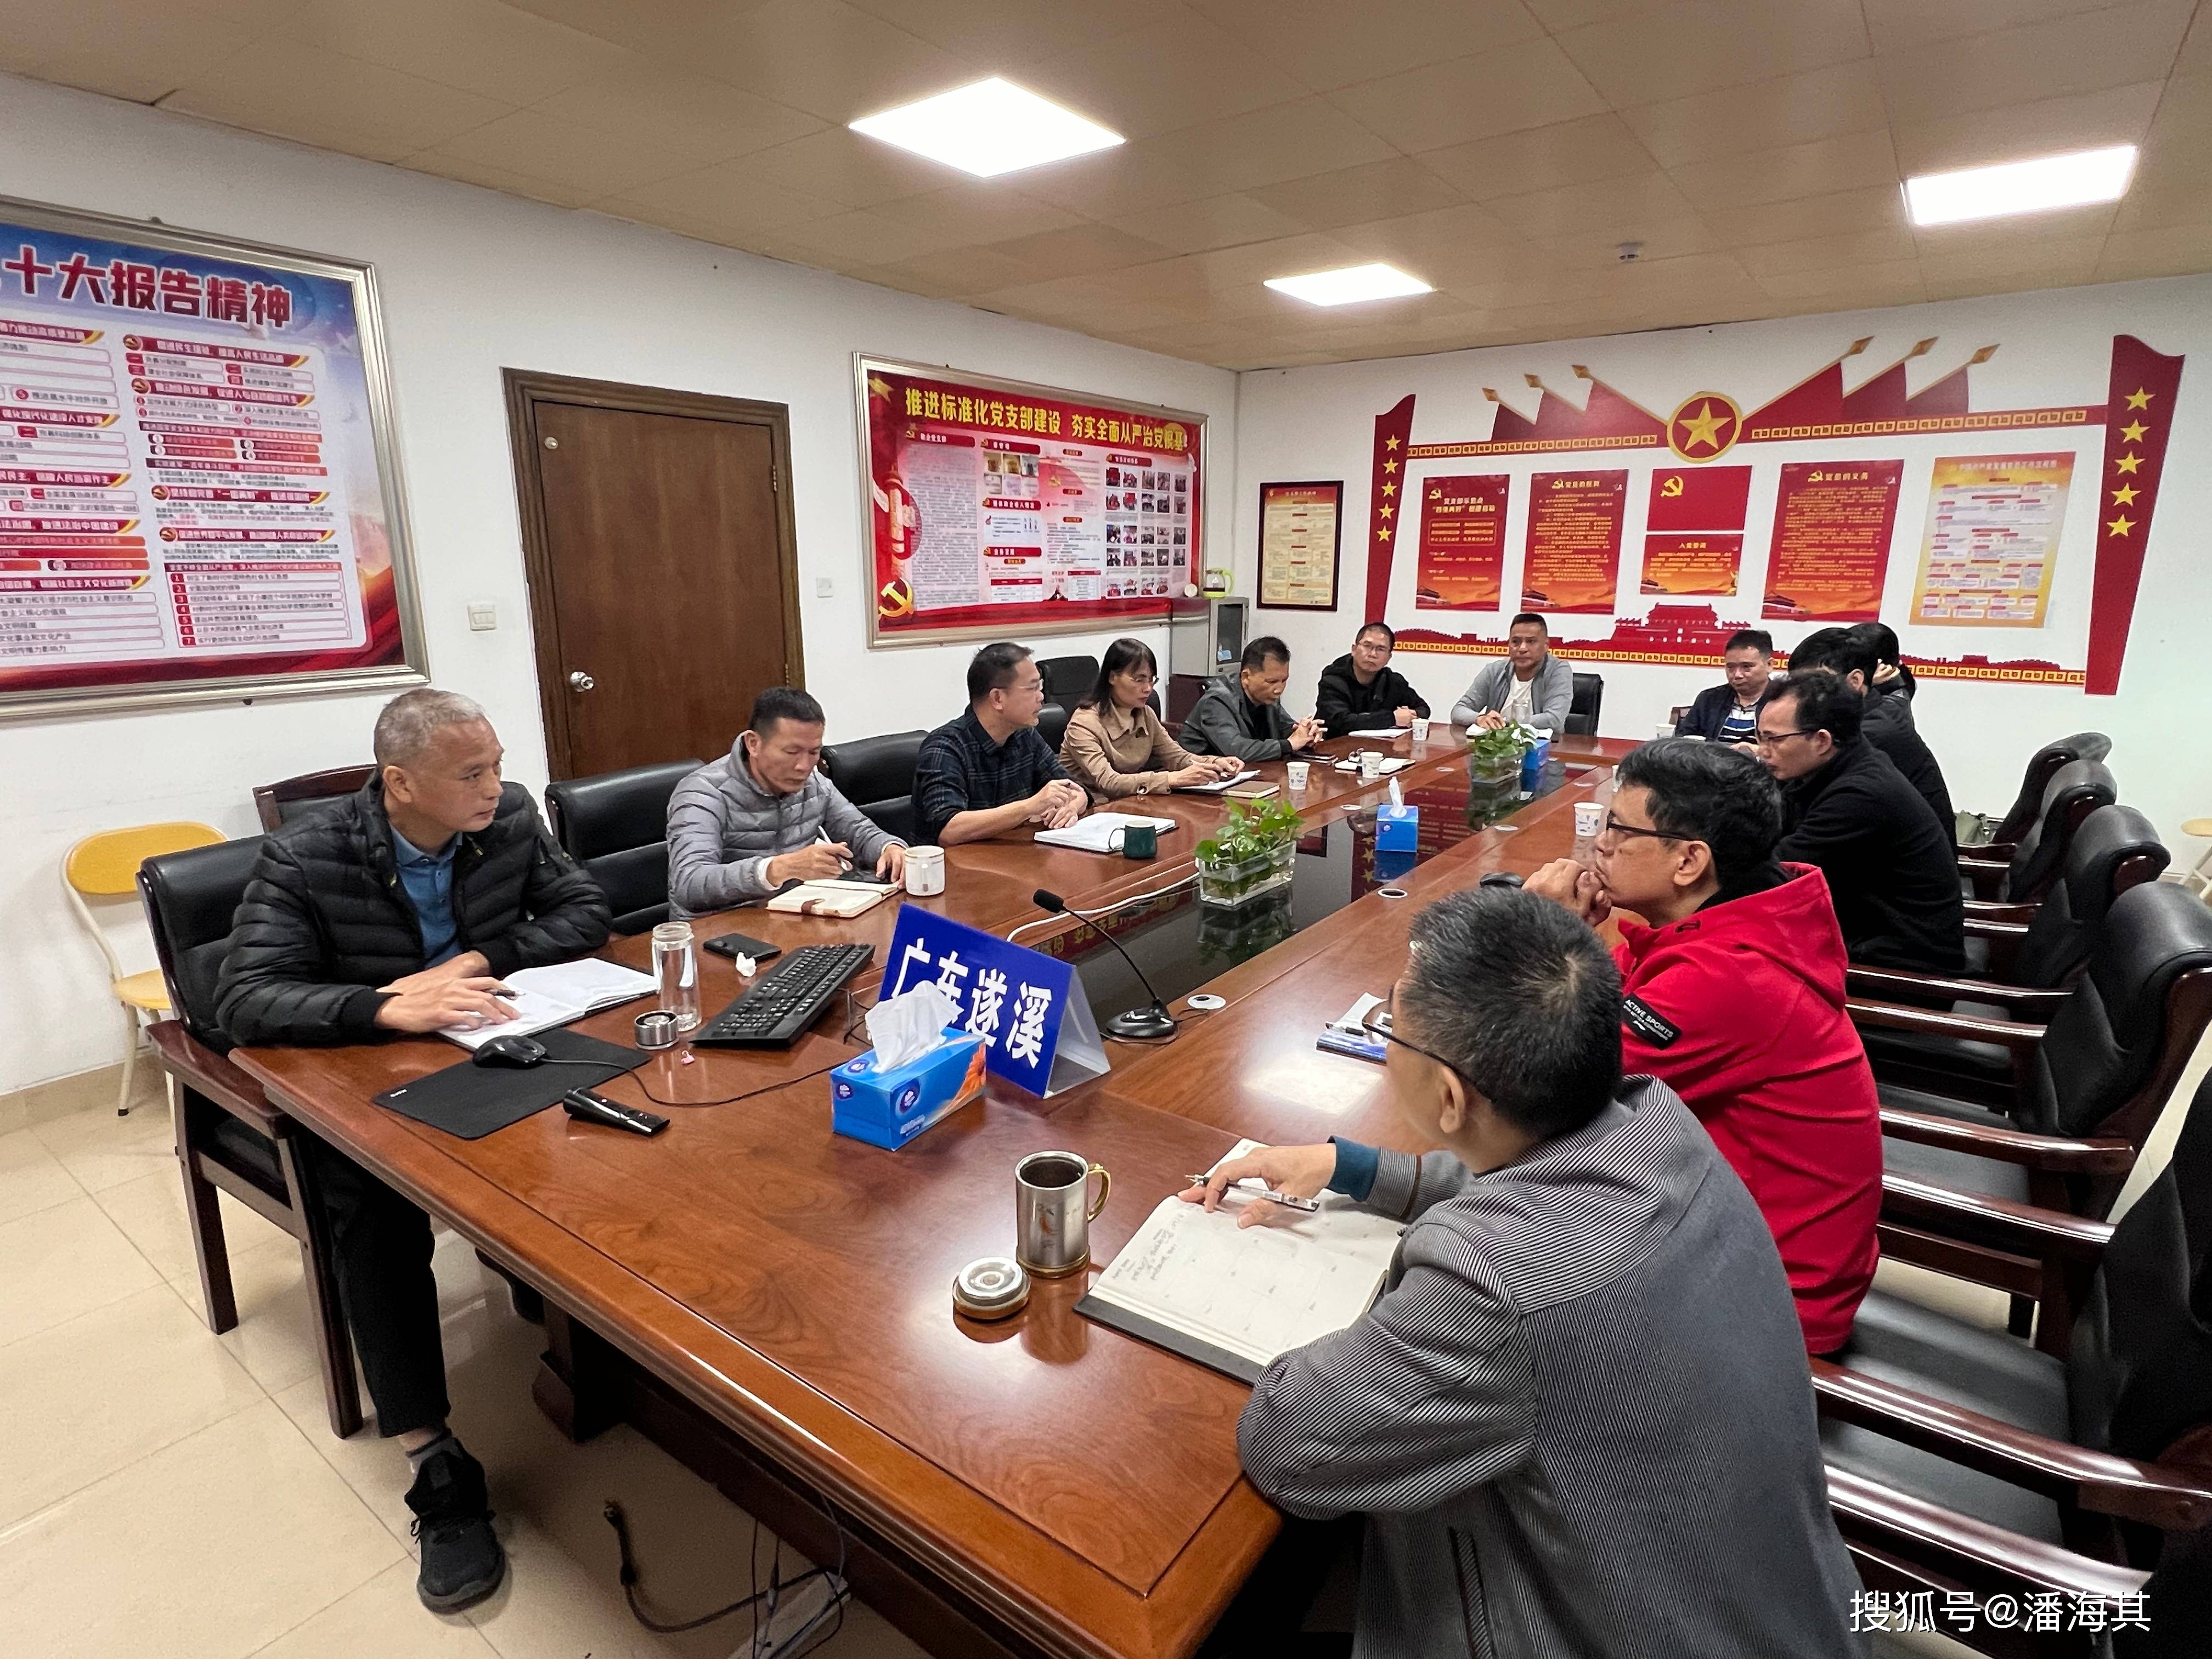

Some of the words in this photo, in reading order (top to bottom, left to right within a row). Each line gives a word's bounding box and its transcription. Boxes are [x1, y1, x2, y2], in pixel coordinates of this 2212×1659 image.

[3, 246, 292, 328] 十大报告精神
[906, 387, 1061, 435] 推进标准化党支部建设
[891, 938, 1053, 1069] 广东遂溪
[1645, 1015, 1674, 1038] SPORTS
